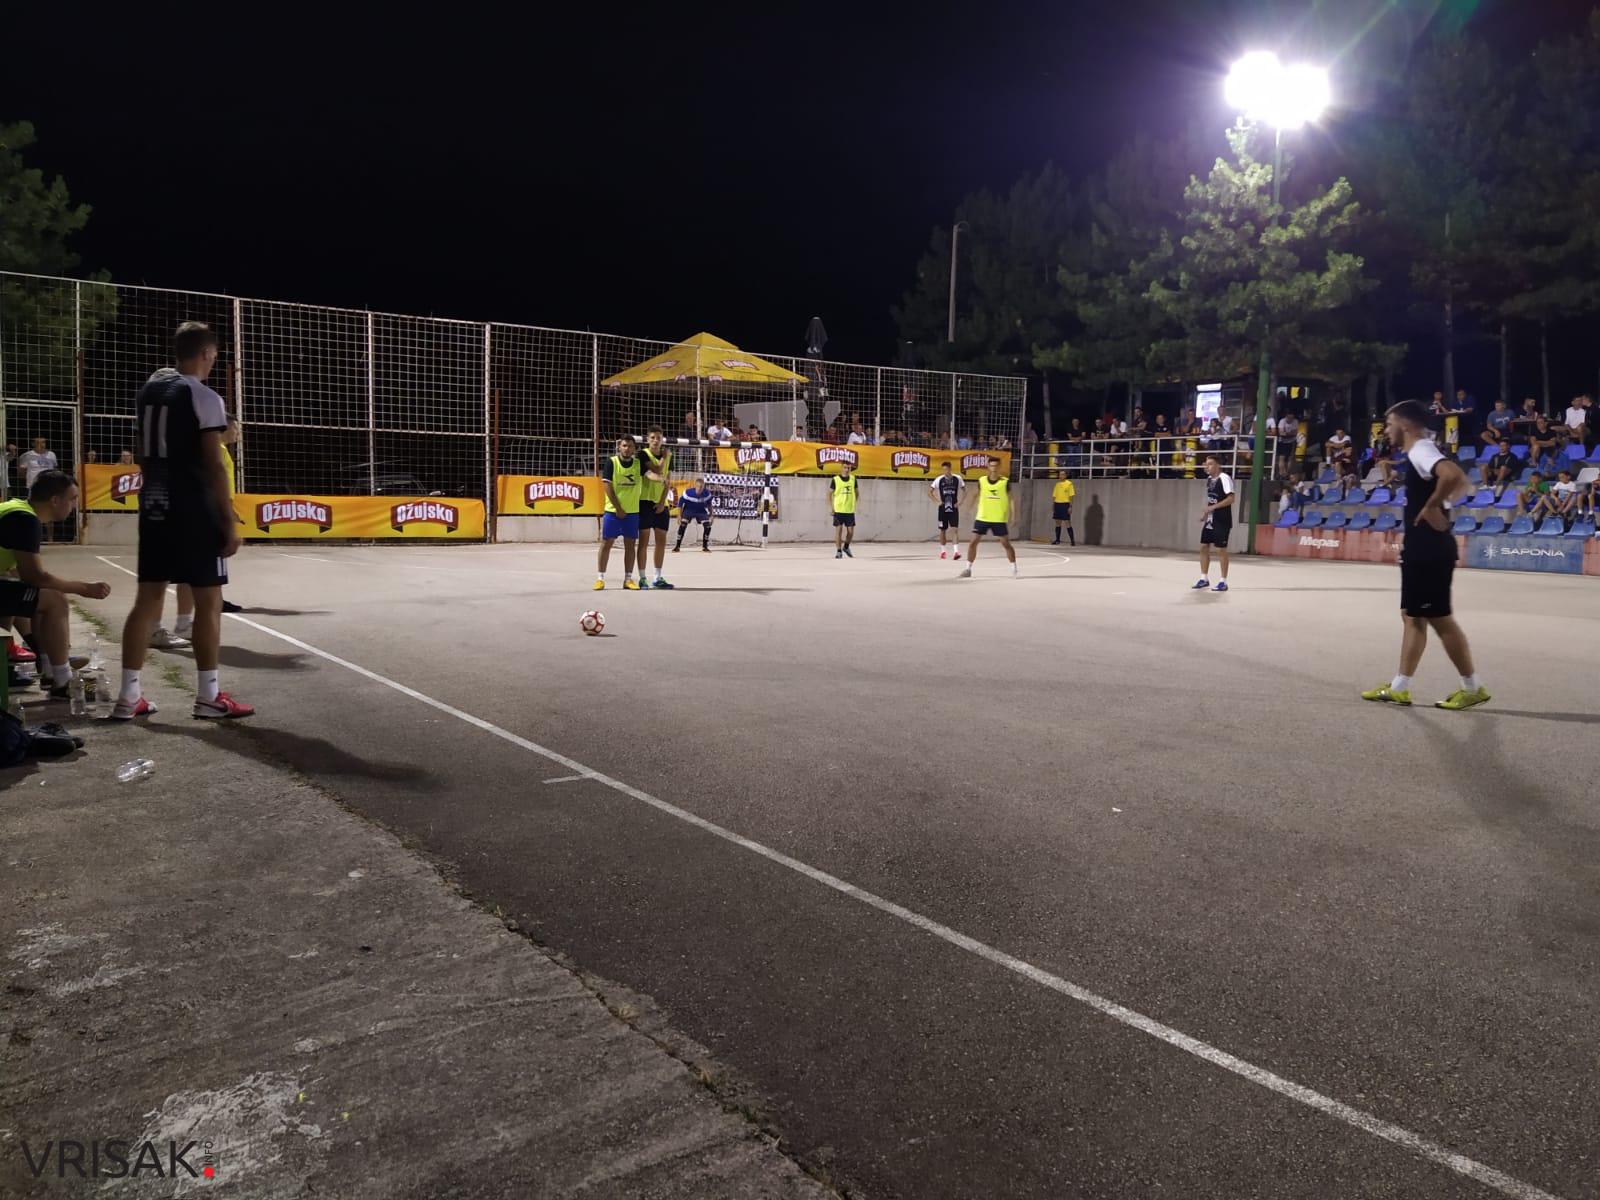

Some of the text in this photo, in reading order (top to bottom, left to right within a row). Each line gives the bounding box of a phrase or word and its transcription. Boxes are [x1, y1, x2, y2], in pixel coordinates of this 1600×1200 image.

[143, 404, 168, 458] 11
[819, 446, 856, 464] Ožujsko
[894, 450, 928, 467] Ožujsko
[529, 480, 579, 500] Ožujsko
[262, 499, 327, 522] Ožujsko
[397, 501, 454, 523] Ožujsko
[1299, 535, 1340, 549] Mepas
[1500, 547, 1565, 558] SAPONIA
